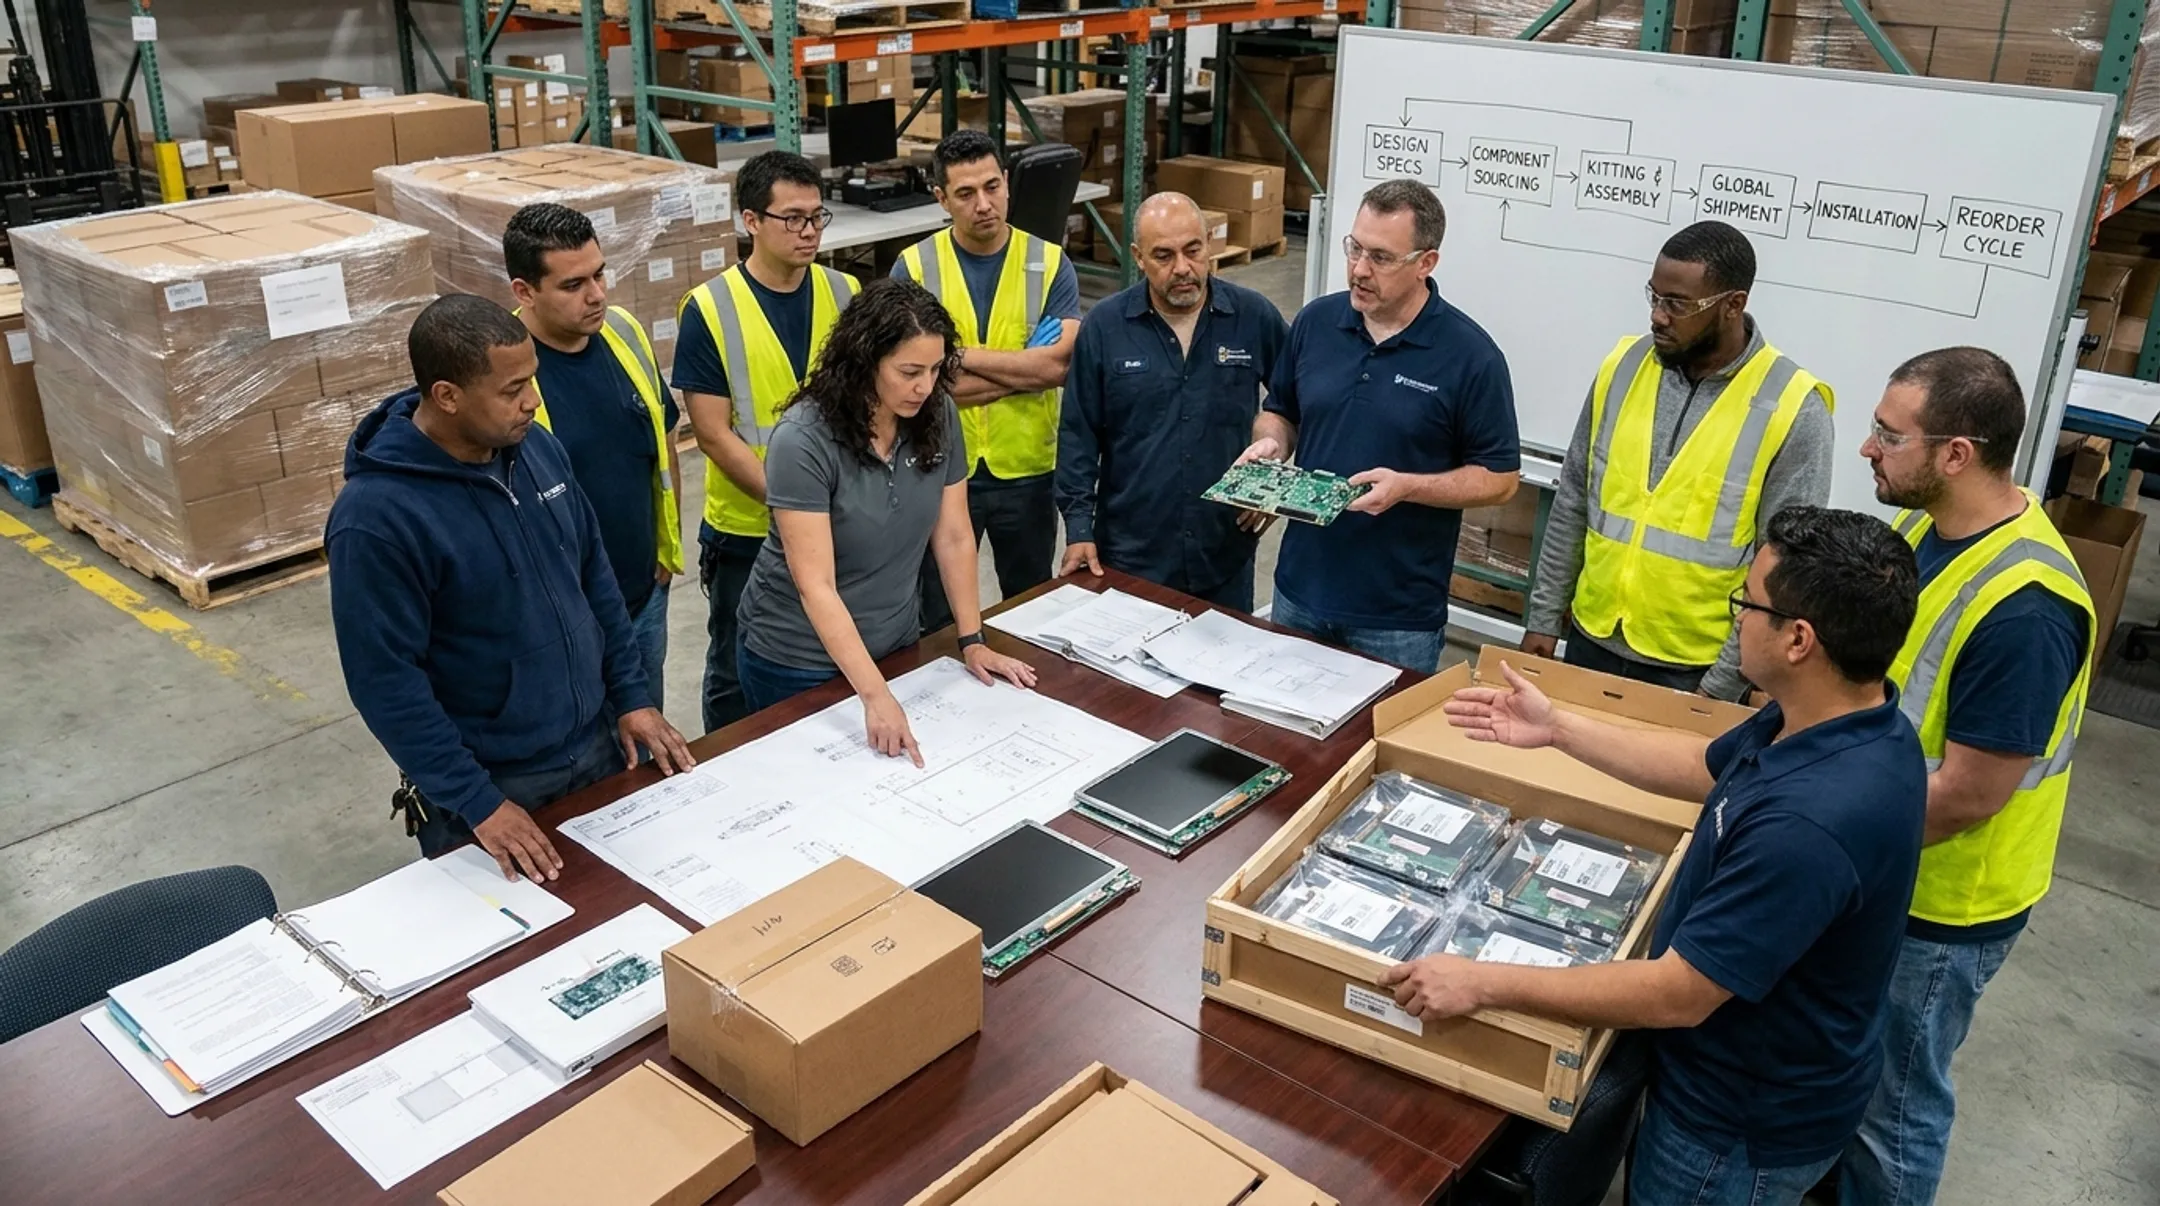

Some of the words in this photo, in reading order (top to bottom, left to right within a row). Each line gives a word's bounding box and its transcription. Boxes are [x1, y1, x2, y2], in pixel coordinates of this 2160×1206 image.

[1373, 132, 1429, 154] DESIGN
[1376, 155, 1423, 176] SPECS
[1472, 145, 1551, 169] COMPONENT
[1473, 169, 1540, 191] SOURCING
[1586, 160, 1646, 181] KITTING
[1653, 165, 1663, 187] &
[1584, 185, 1661, 209] ASSEMBLY
[1712, 174, 1775, 198] GLOBAL
[1702, 198, 1783, 225] SHIPMENT
[1816, 200, 1919, 231] INSTALLATION
[1956, 206, 2046, 237] REORDER
[1963, 234, 2025, 259] CYCLE
